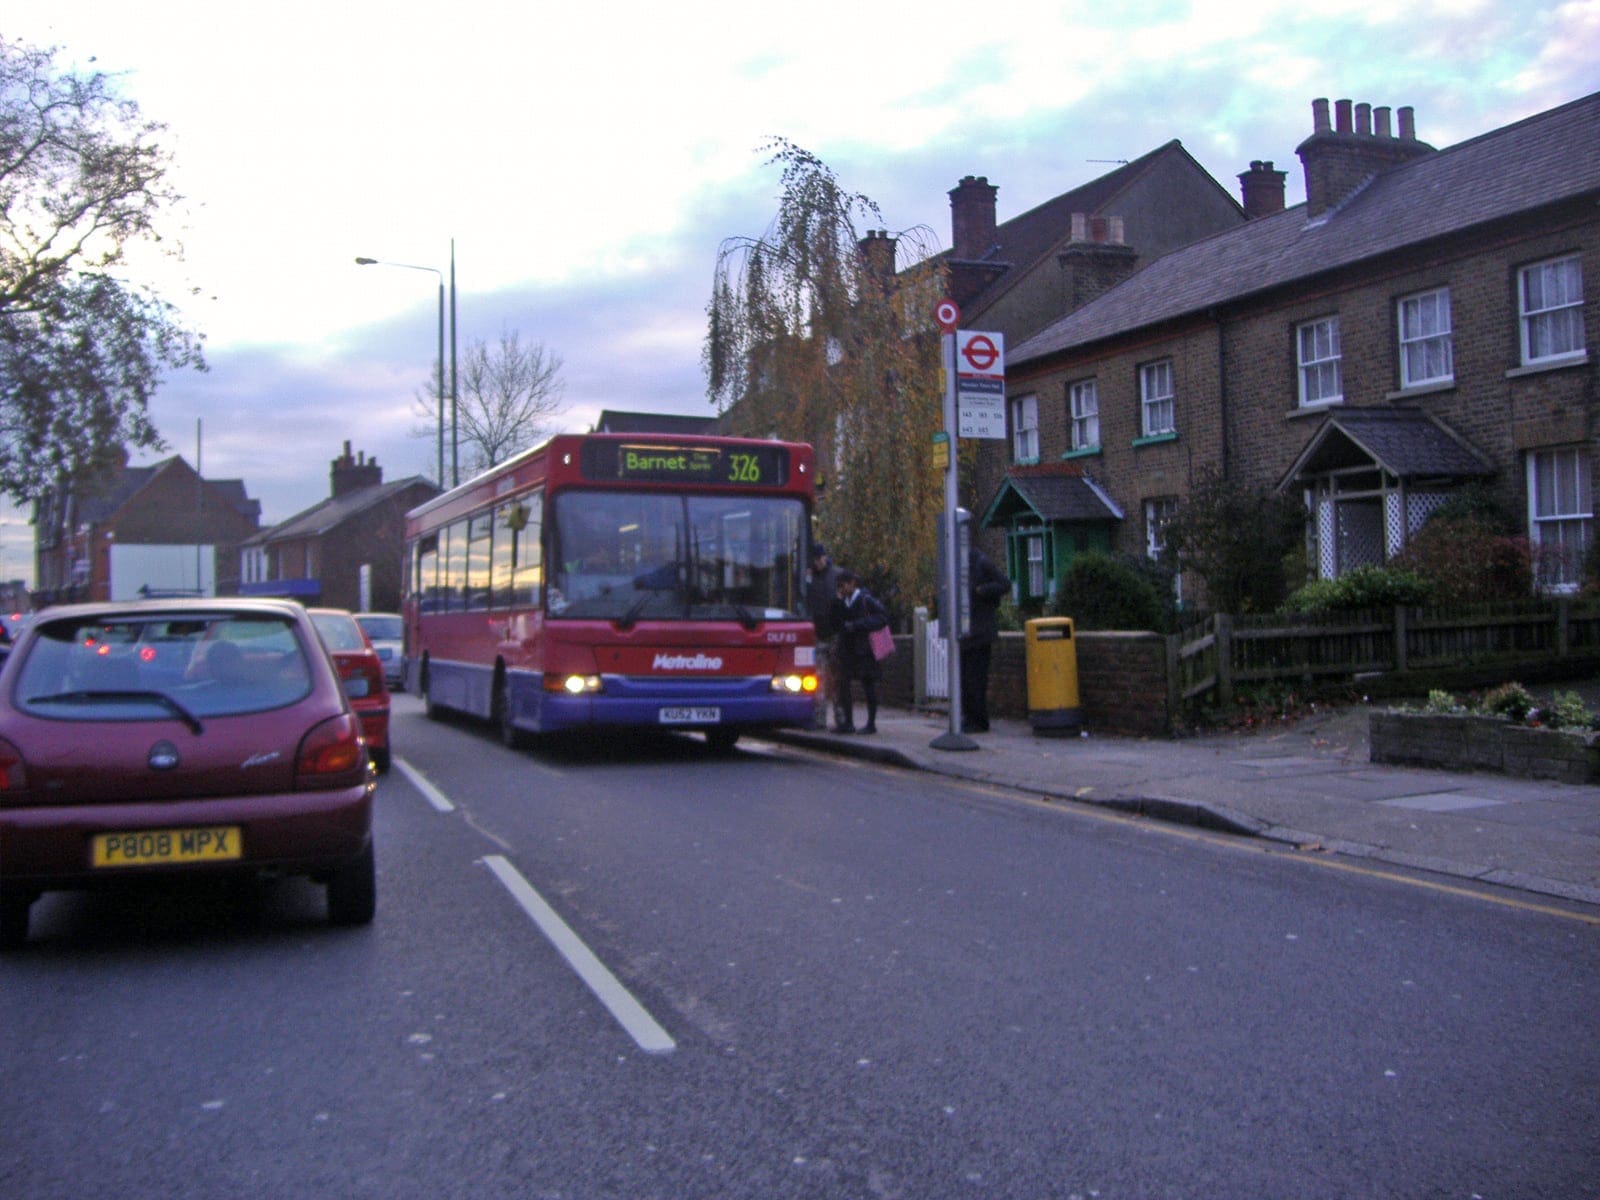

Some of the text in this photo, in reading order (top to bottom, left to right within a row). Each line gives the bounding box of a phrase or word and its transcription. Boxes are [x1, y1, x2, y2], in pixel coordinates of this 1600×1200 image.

[626, 452, 686, 470] Barnet
[728, 454, 760, 482] 326
[652, 653, 723, 670] Metroline
[106, 833, 171, 860] P808
